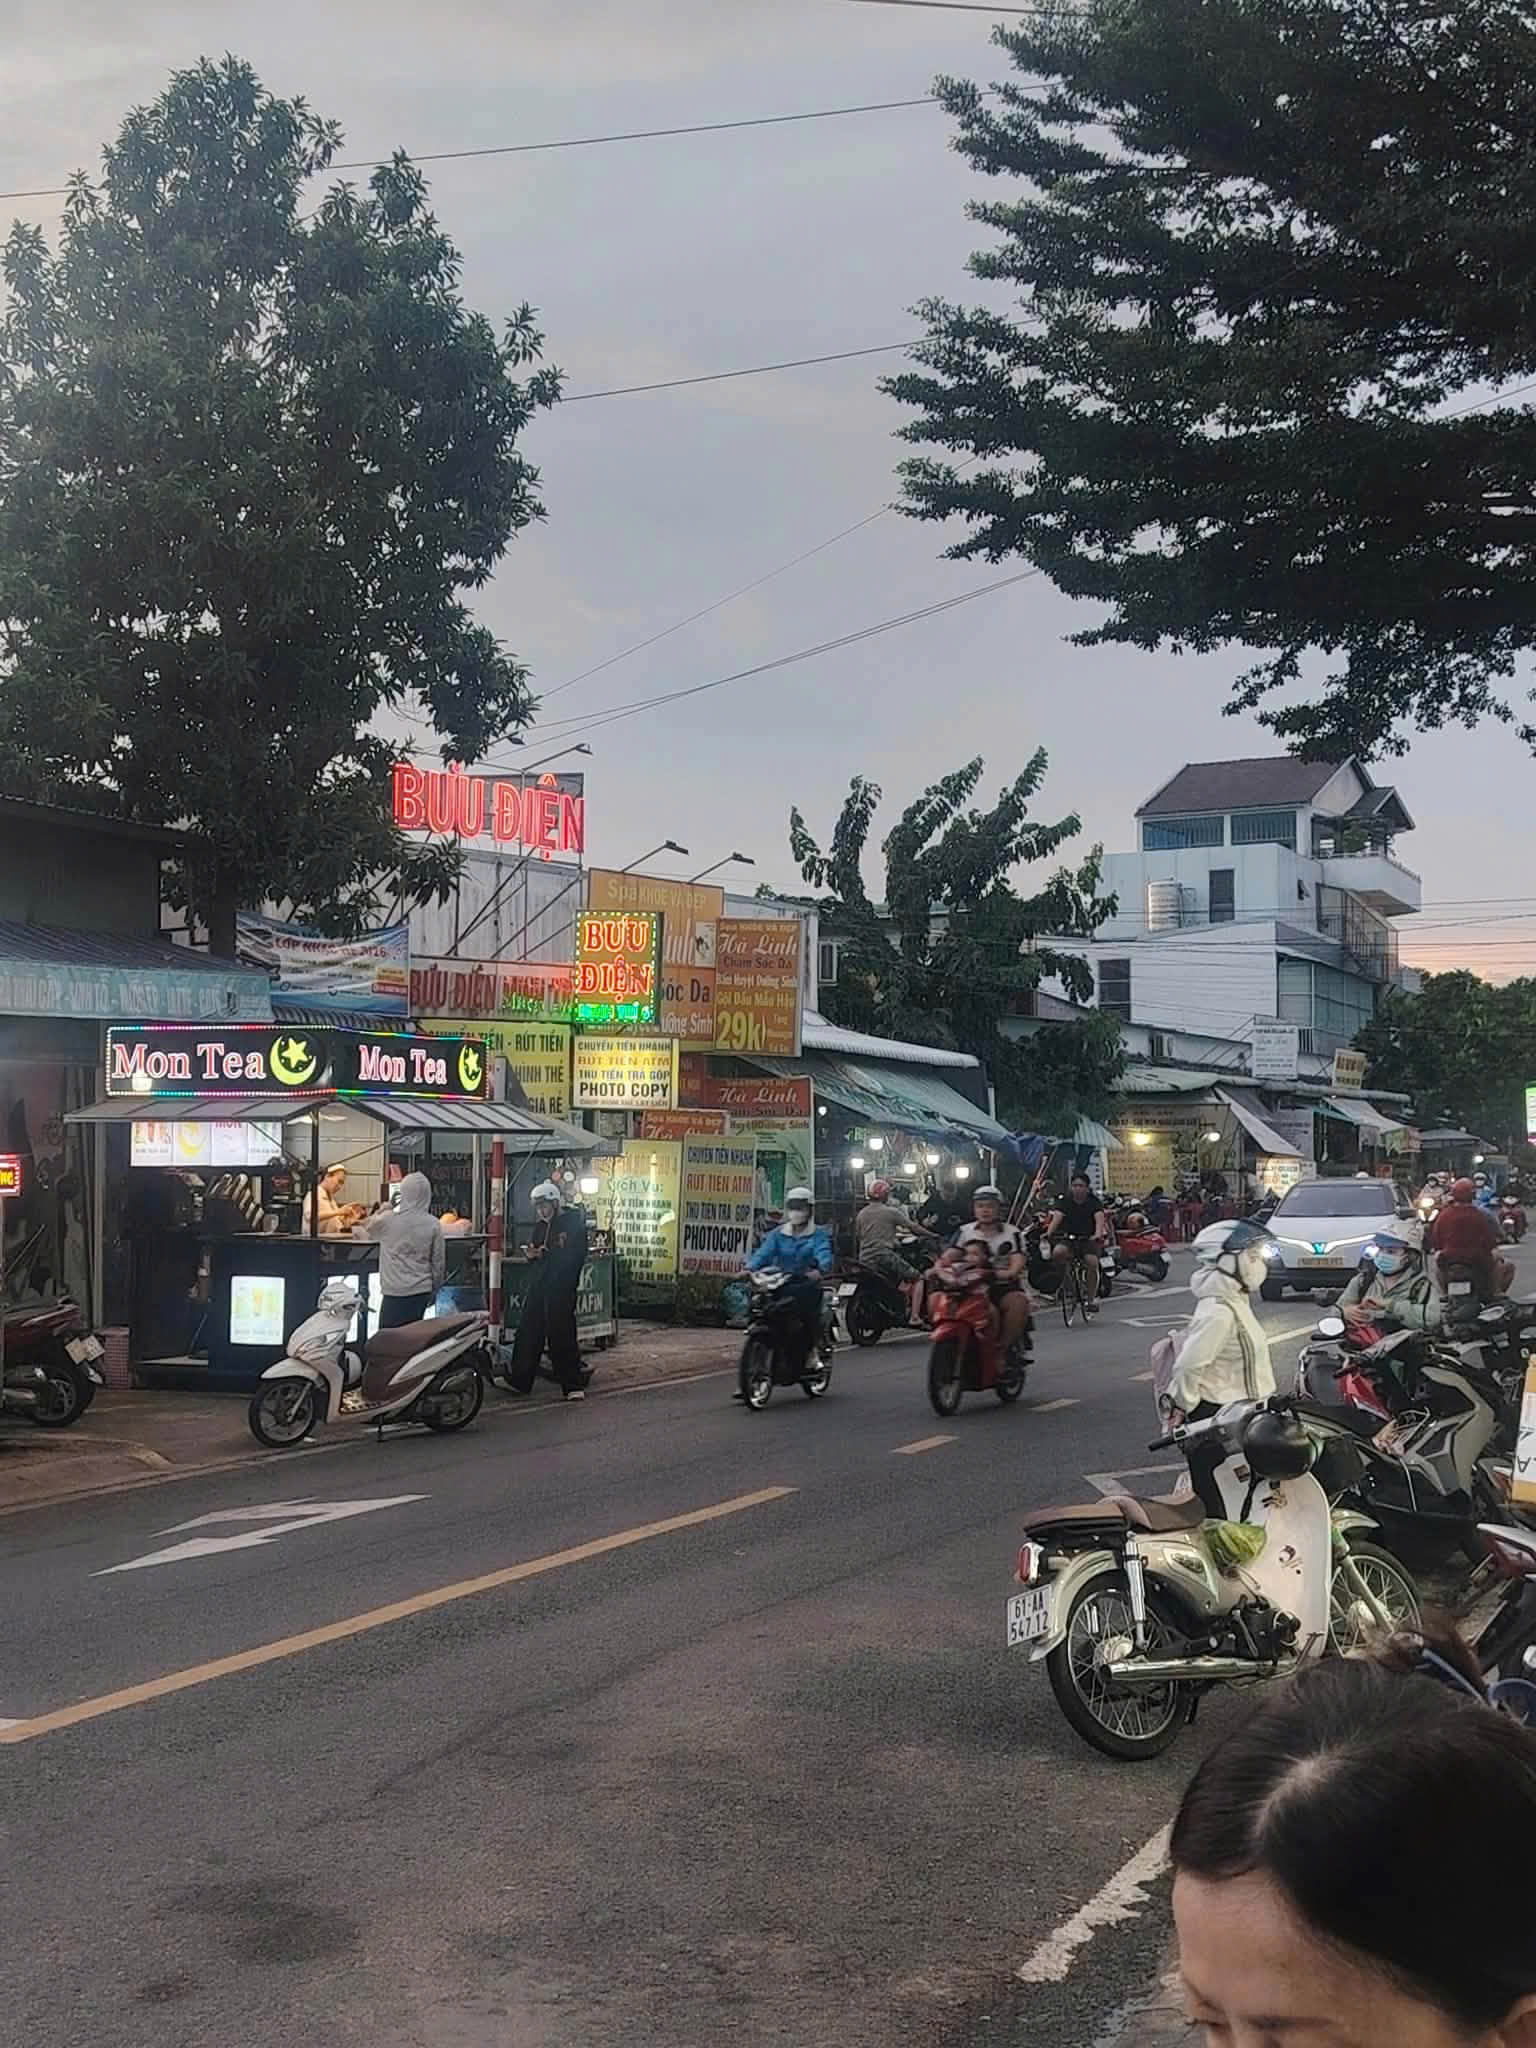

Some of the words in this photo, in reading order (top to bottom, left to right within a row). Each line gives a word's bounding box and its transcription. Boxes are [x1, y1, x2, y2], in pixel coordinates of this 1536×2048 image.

[393, 762, 485, 838] BƯU
[493, 773, 585, 862] ĐIỆN
[584, 915, 649, 952] BƯU
[577, 953, 652, 1002] ĐIỆN
[690, 979, 710, 1002] Da
[516, 1030, 537, 1052] RÚT
[112, 1043, 192, 1079] Mon
[197, 1043, 267, 1079] Tea
[358, 1044, 406, 1083] Mon
[410, 1048, 447, 1085] Tea
[580, 1082, 625, 1097] PHOTO
[630, 1083, 669, 1098] COPY
[684, 1223, 749, 1254] PHOTOCOPY
